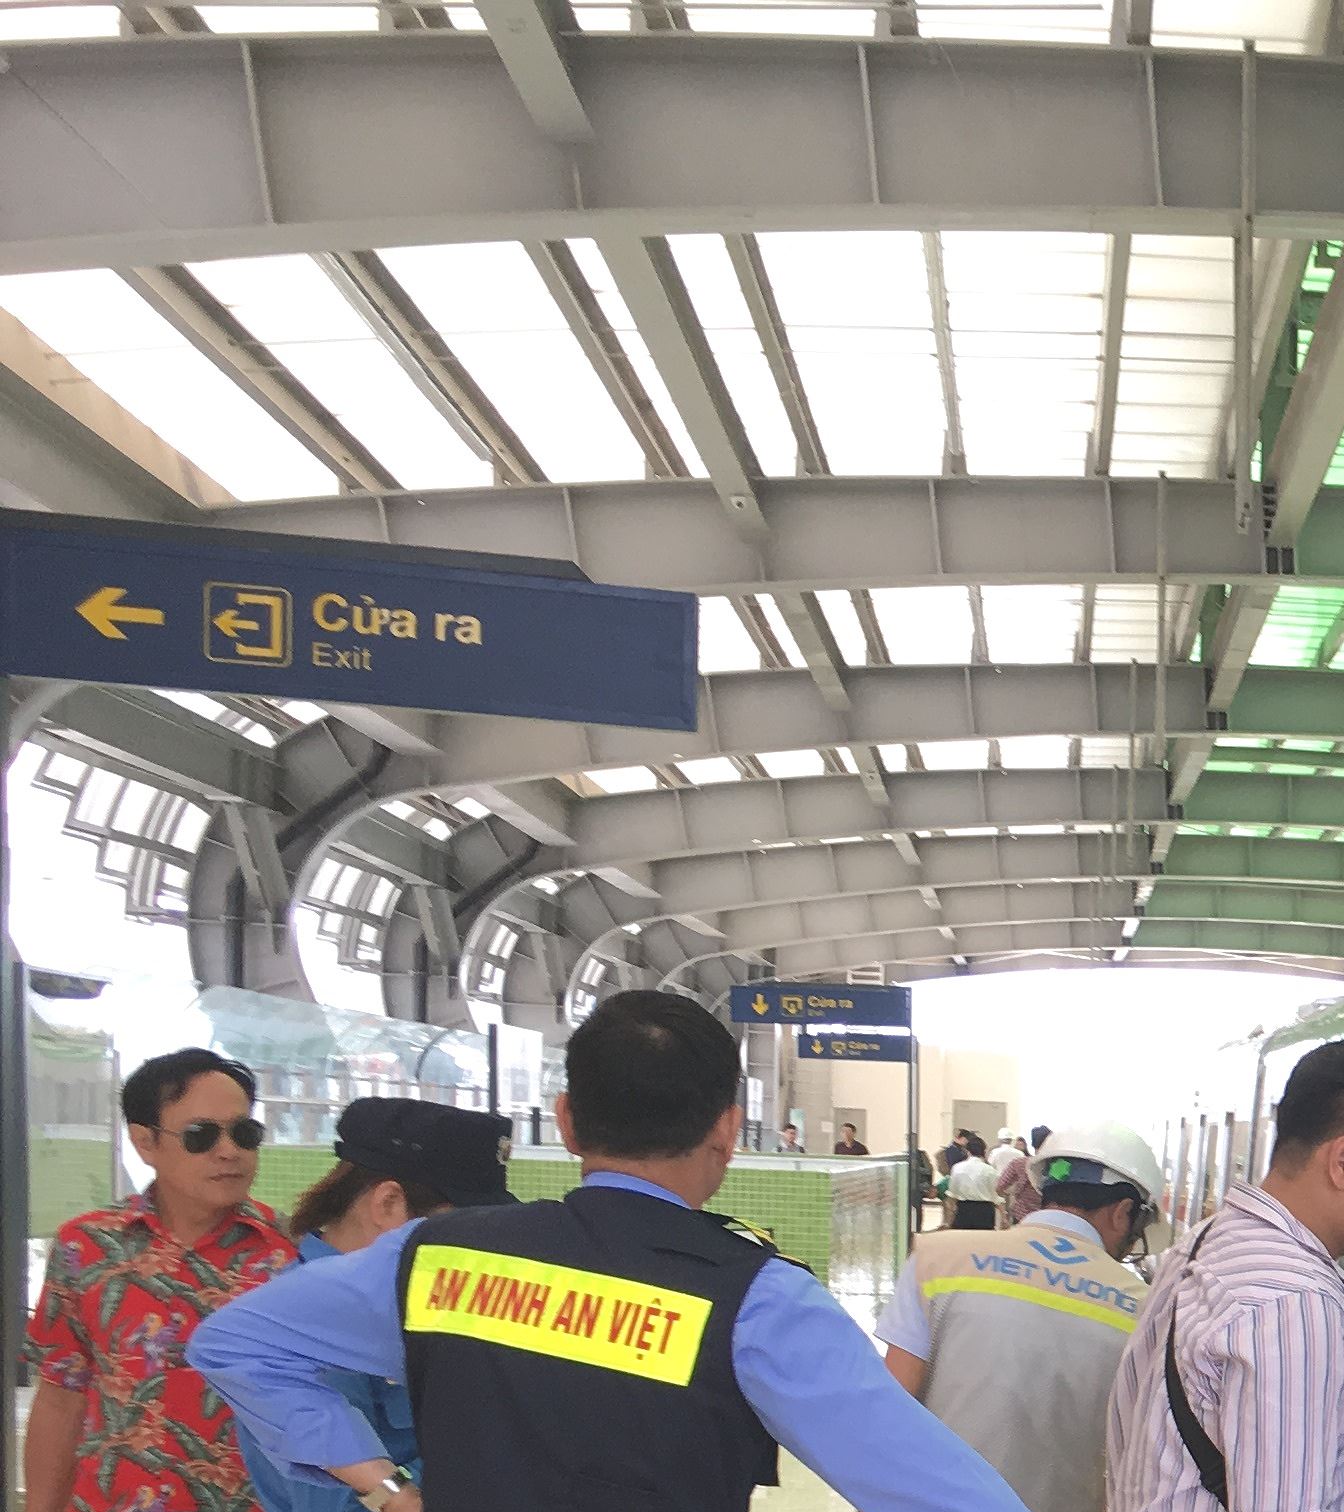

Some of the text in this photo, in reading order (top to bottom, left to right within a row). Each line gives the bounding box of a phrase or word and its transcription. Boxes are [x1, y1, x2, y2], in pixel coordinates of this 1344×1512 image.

[312, 592, 483, 646] Cửa ra
[311, 640, 374, 672] Exit
[426, 1267, 682, 1360] AN NINH AN VIỆT
